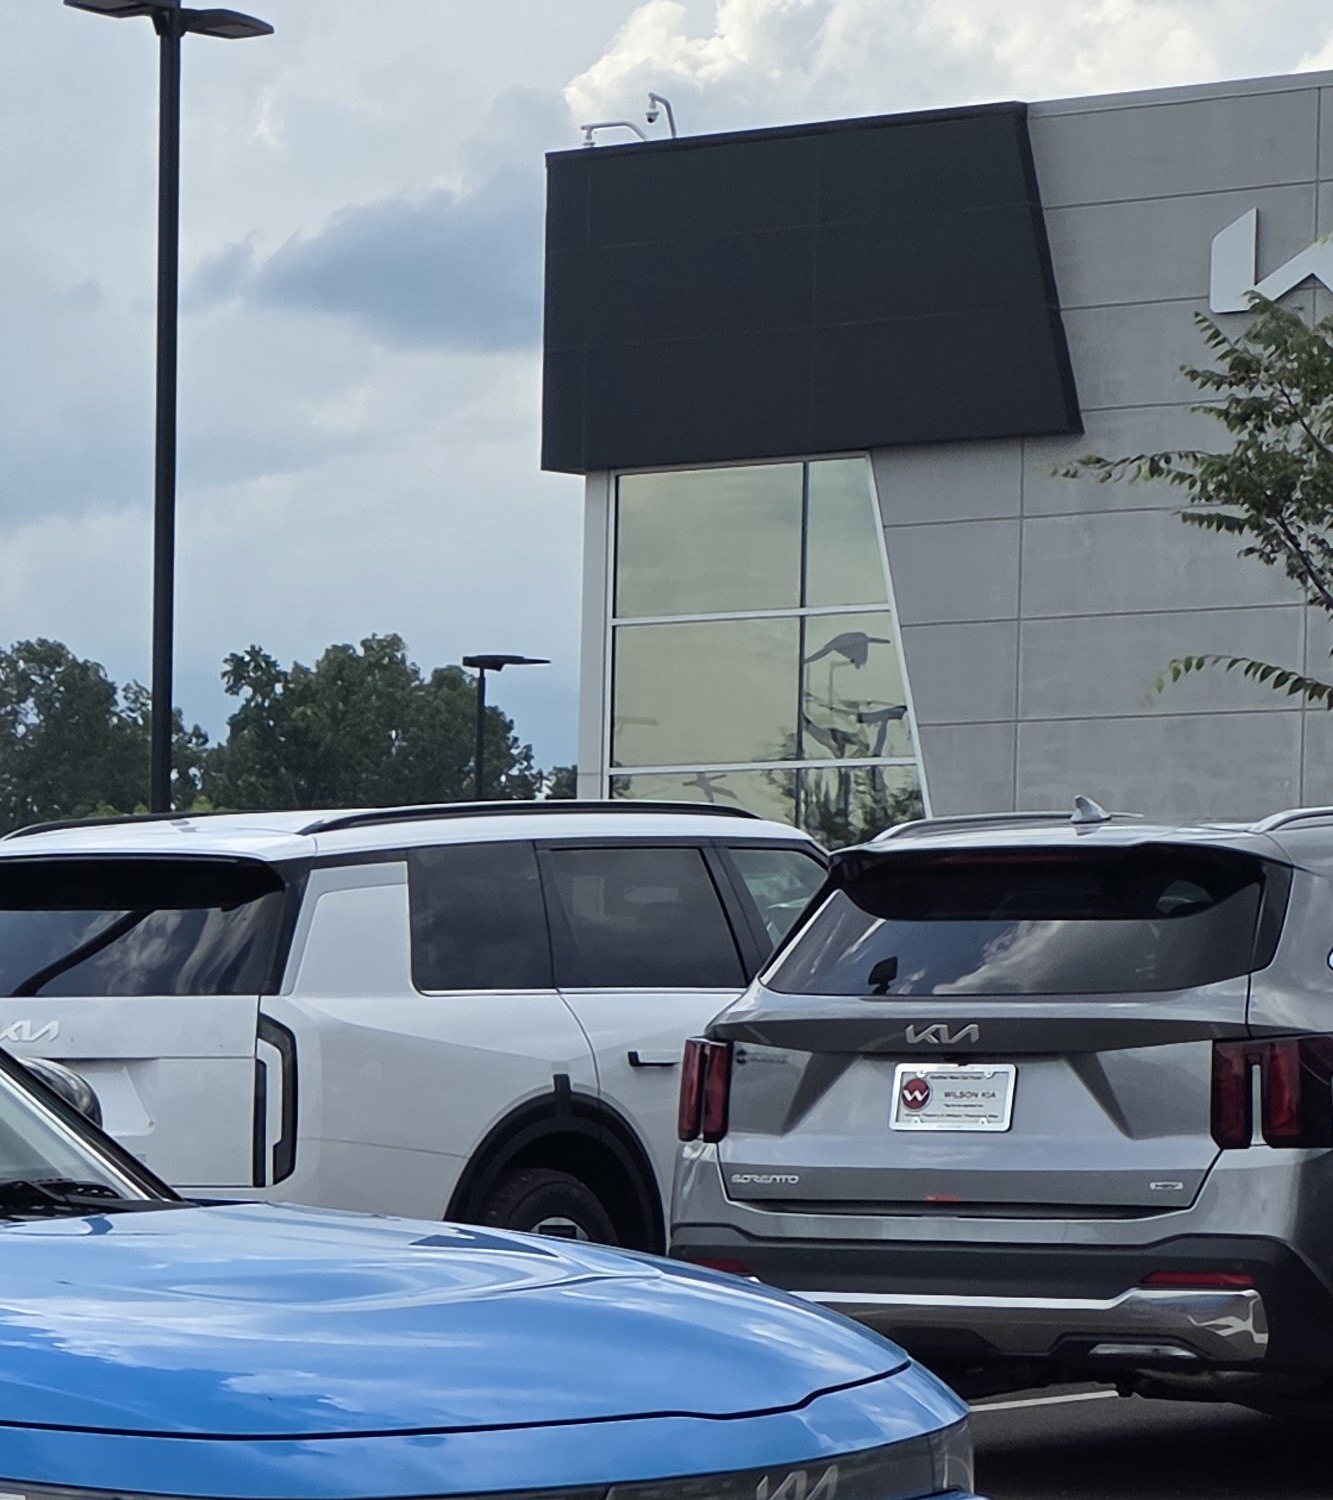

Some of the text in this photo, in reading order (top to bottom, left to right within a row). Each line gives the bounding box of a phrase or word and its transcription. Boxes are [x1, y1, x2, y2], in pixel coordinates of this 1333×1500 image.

[905, 1024, 979, 1043] KIA
[944, 1091, 978, 1099] WILSON
[731, 1174, 800, 1184] SORENTO
